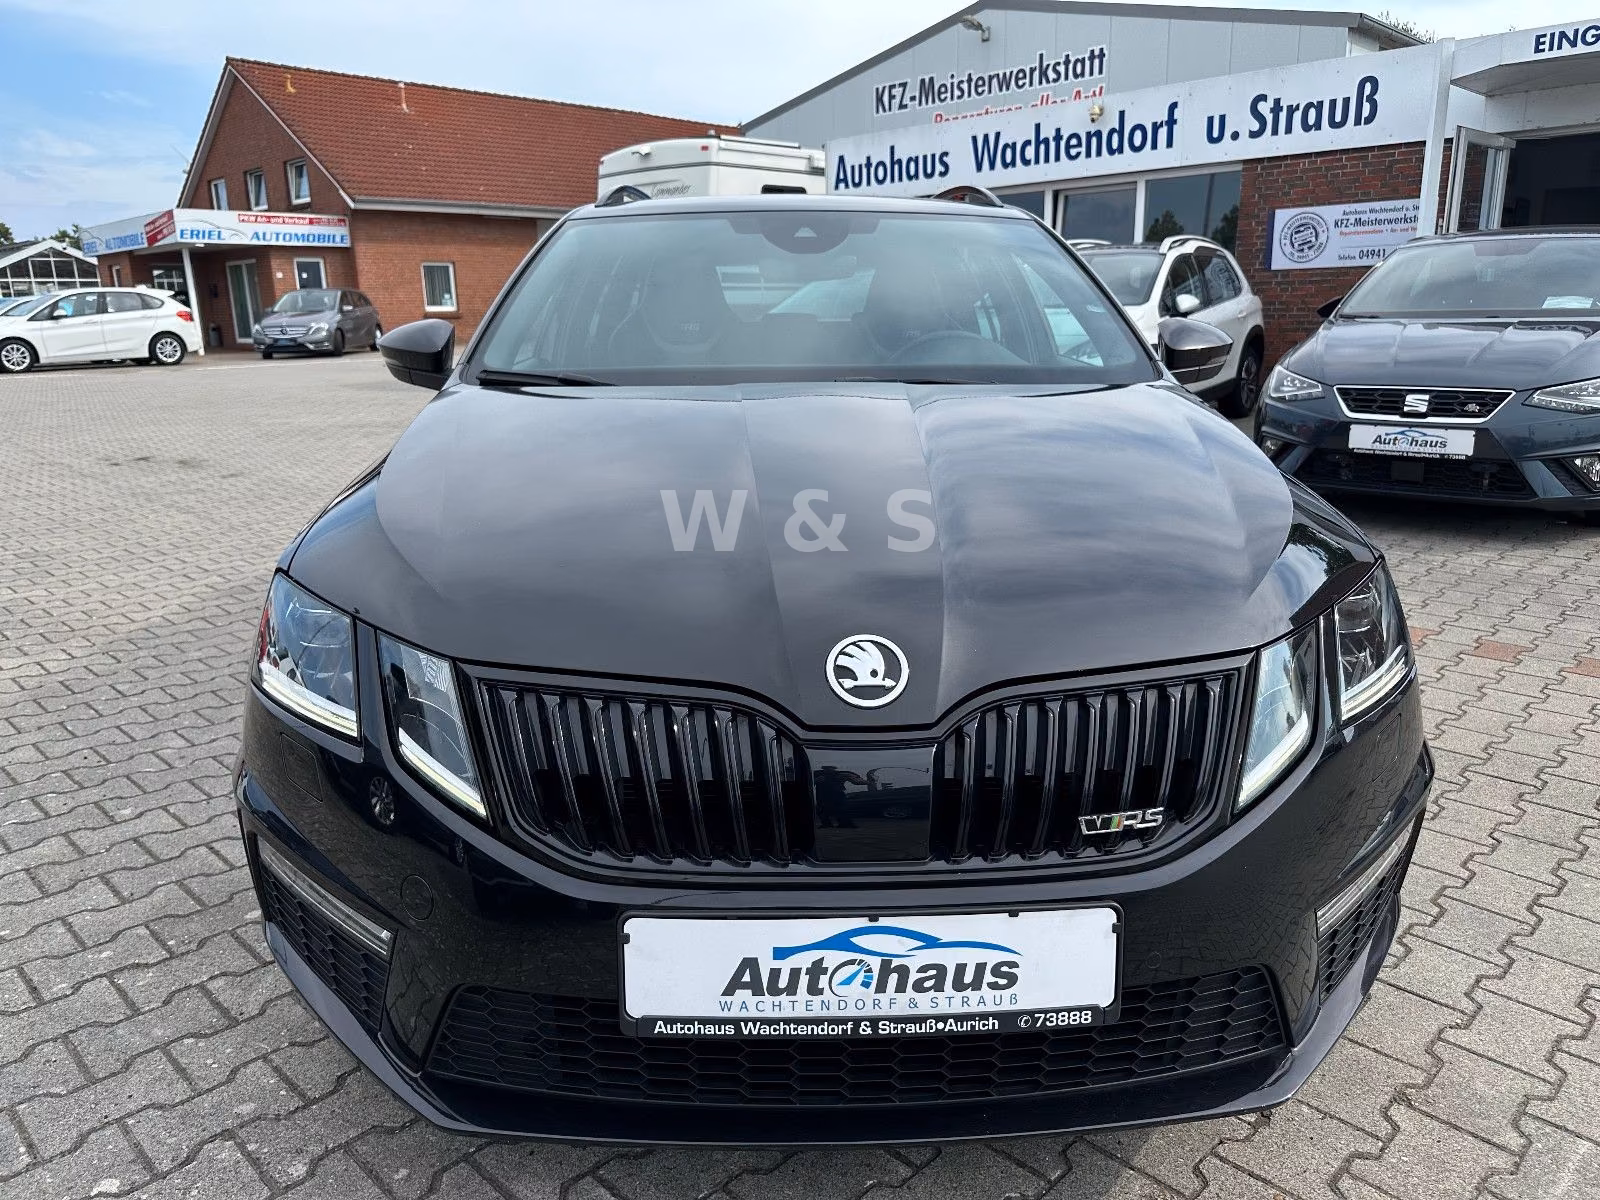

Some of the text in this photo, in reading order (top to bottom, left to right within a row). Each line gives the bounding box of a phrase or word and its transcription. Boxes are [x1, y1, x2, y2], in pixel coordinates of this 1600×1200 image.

[874, 47, 1107, 115] KFZ-Meisterwerkstatt
[834, 145, 950, 191] Autohaus
[971, 102, 1178, 173] Wachtendorf
[1249, 75, 1380, 139] Strauß
[180, 227, 349, 246] ERIEL AUTOMOBILE
[1358, 248, 1387, 261] 04941
[1372, 434, 1448, 449] Autohaus
[720, 956, 1020, 997] Autohaus
[719, 997, 898, 1012] WACHTENDORF
[908, 997, 919, 1009] &
[653, 1021, 735, 1036] Autohaus
[740, 1020, 854, 1036] Wachtendorf
[859, 1021, 872, 1035] &
[1034, 1010, 1093, 1028] 73888
